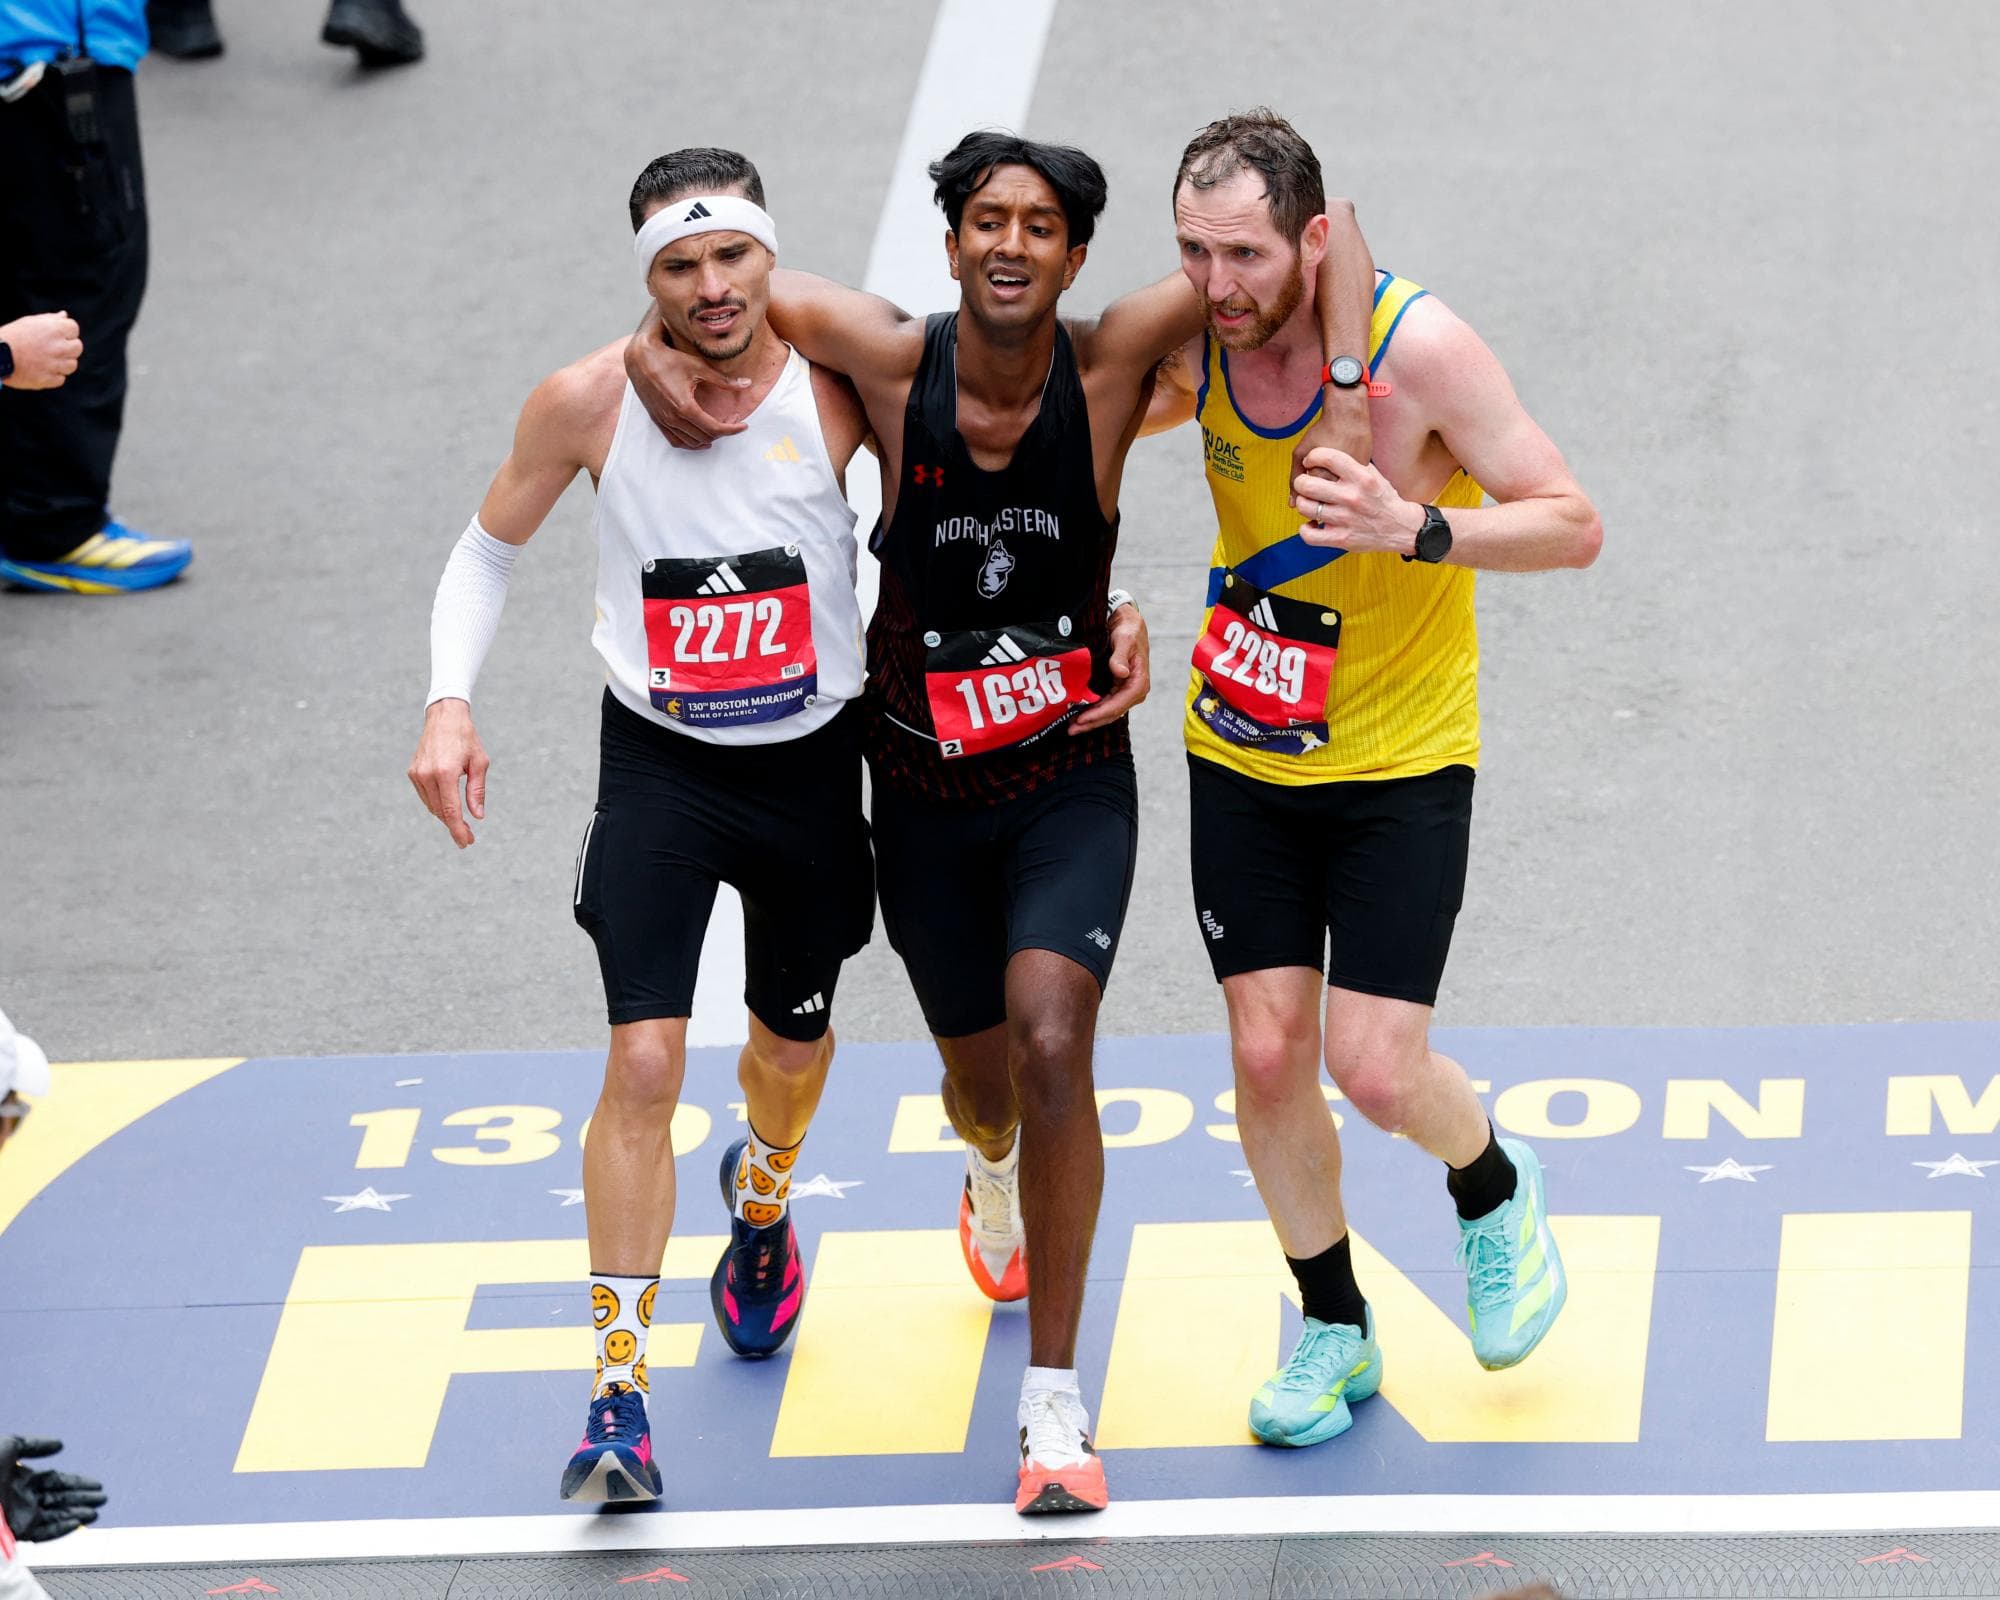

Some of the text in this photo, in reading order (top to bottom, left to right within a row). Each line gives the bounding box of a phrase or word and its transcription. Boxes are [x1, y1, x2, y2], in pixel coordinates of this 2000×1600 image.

[669, 597, 787, 664] 2272
[1210, 621, 1307, 704] 2289
[654, 671, 667, 685] 3
[710, 700, 749, 711] BOSTON
[751, 688, 803, 706] MARATHON
[955, 659, 1067, 730] 1636
[724, 709, 758, 718] AMERICA
[1236, 716, 1260, 737] BOSTON
[944, 742, 958, 755] 2
